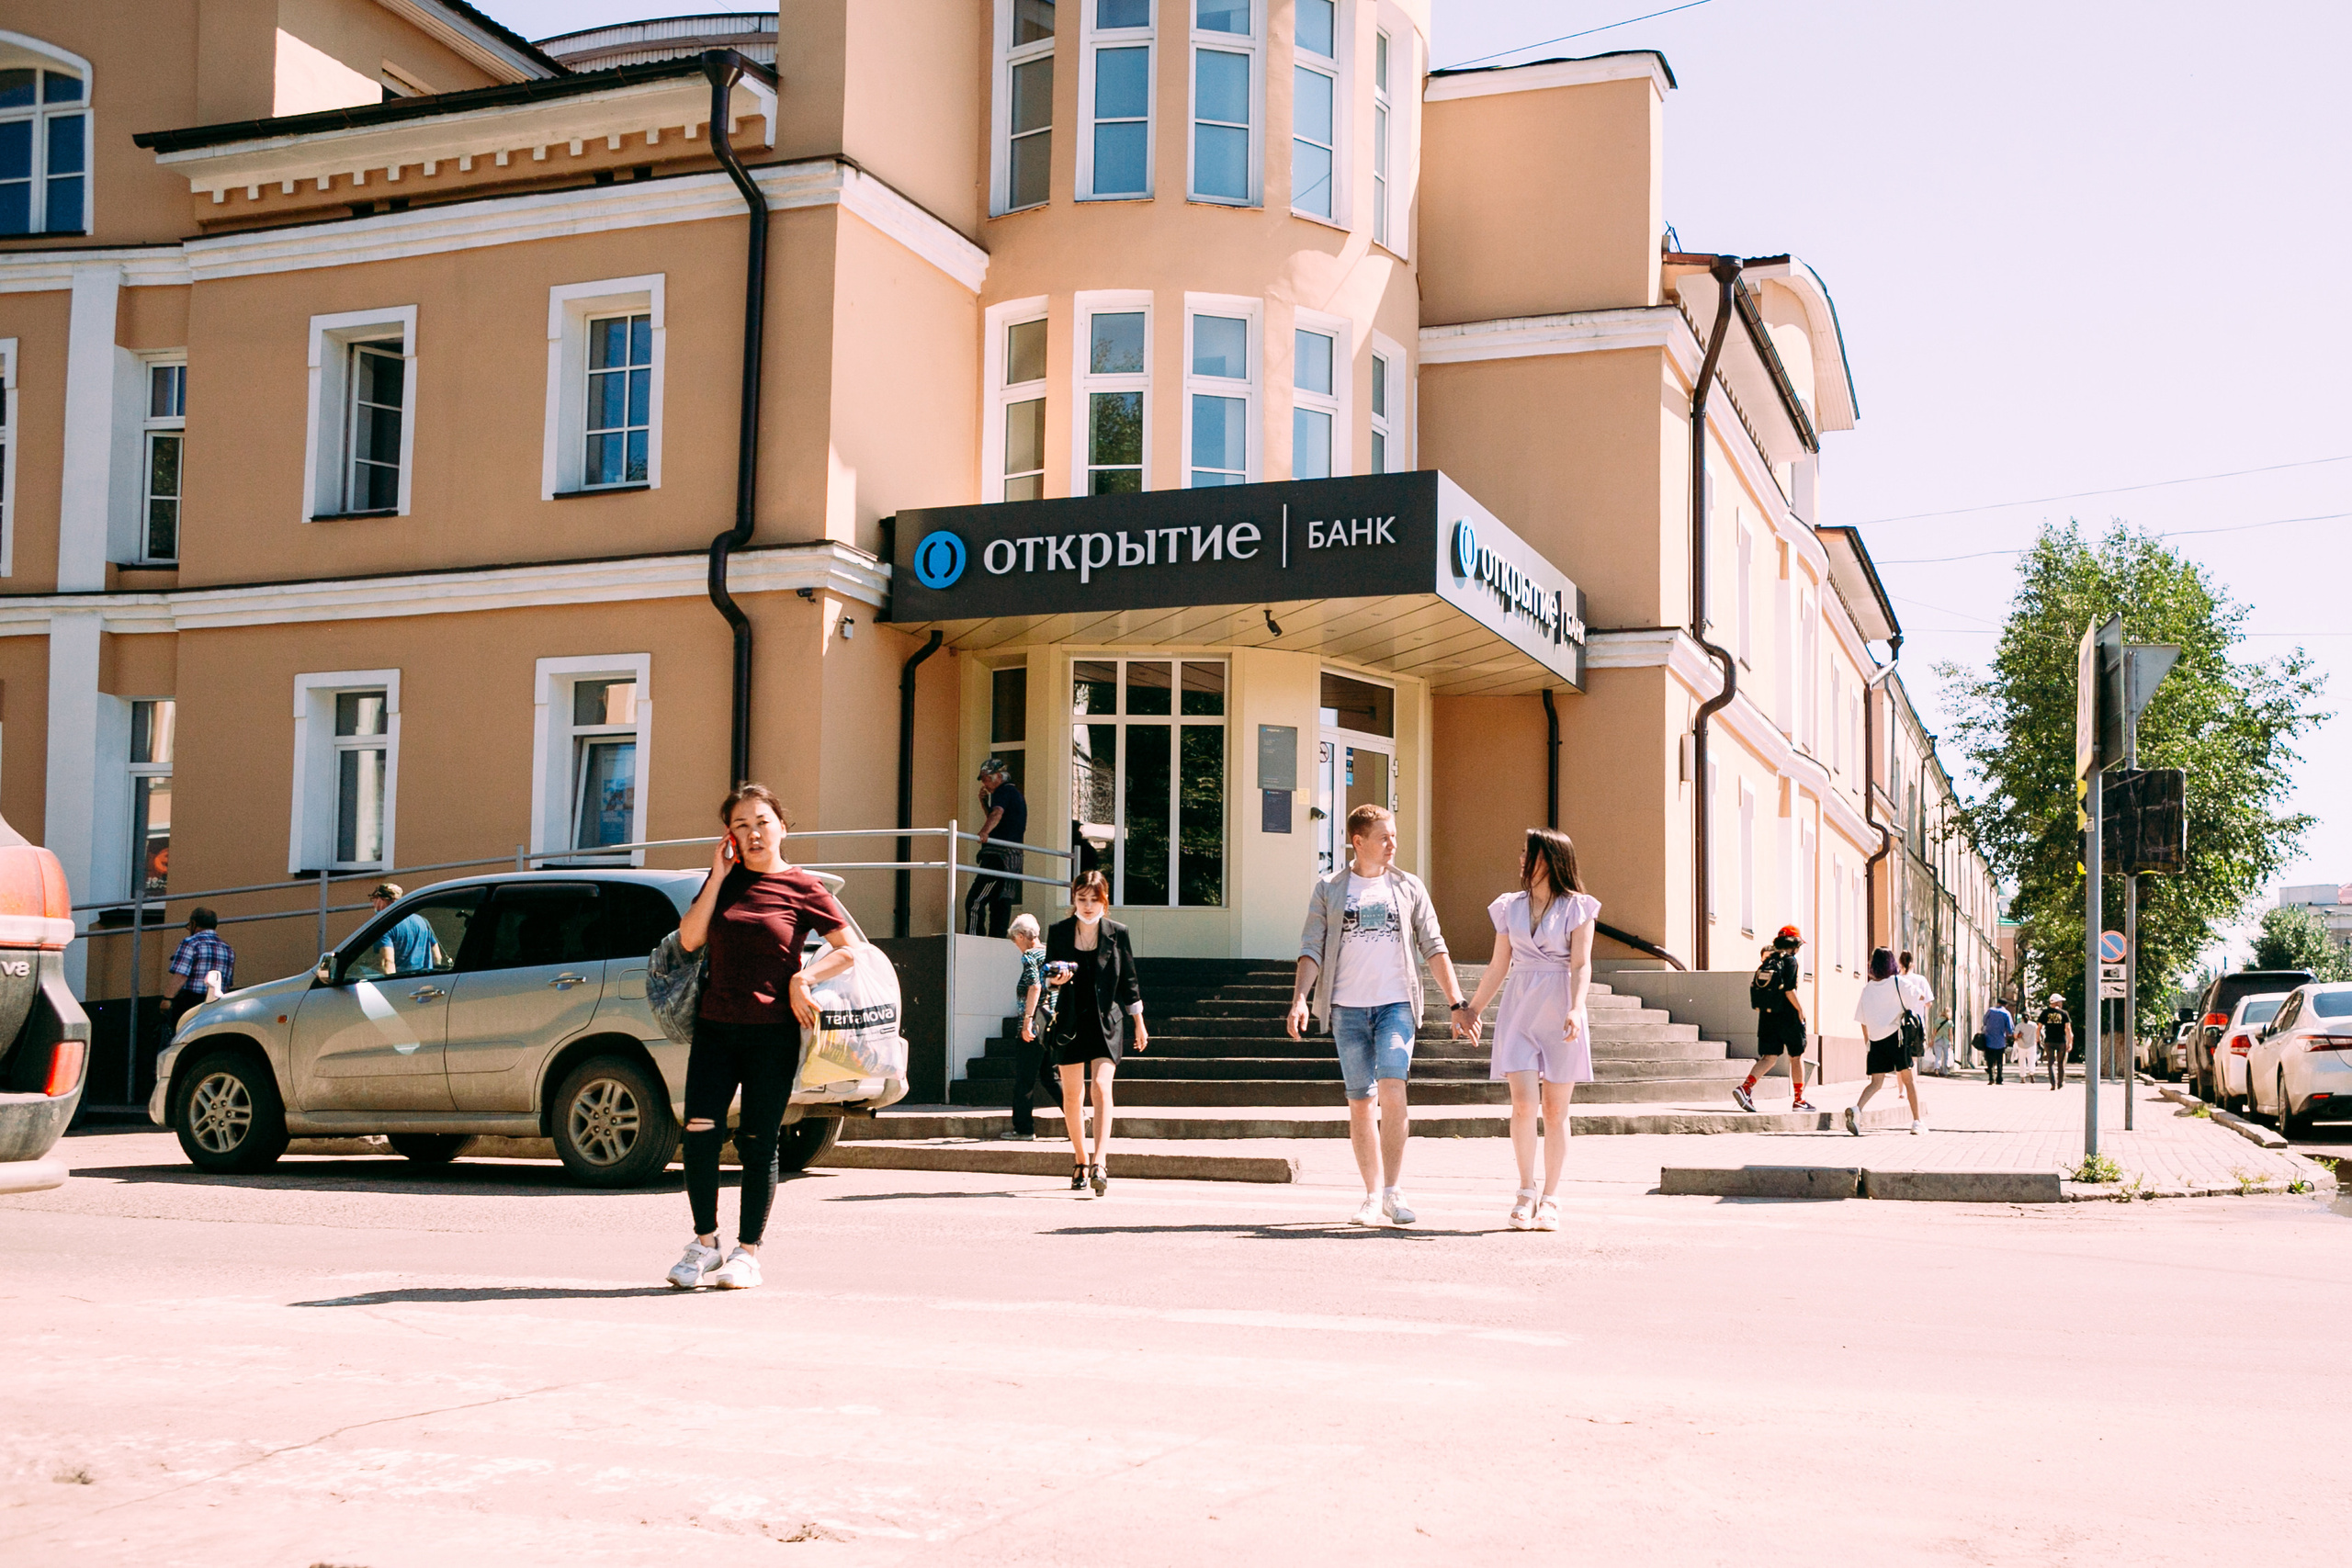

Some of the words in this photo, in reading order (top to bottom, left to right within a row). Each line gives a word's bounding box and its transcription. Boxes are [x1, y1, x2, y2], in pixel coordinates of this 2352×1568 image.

[983, 520, 1261, 583] открытие
[1307, 515, 1396, 549] БАНК
[1481, 544, 1559, 630] открытие
[1566, 610, 1586, 647] БАНК
[1, 961, 30, 977] V8
